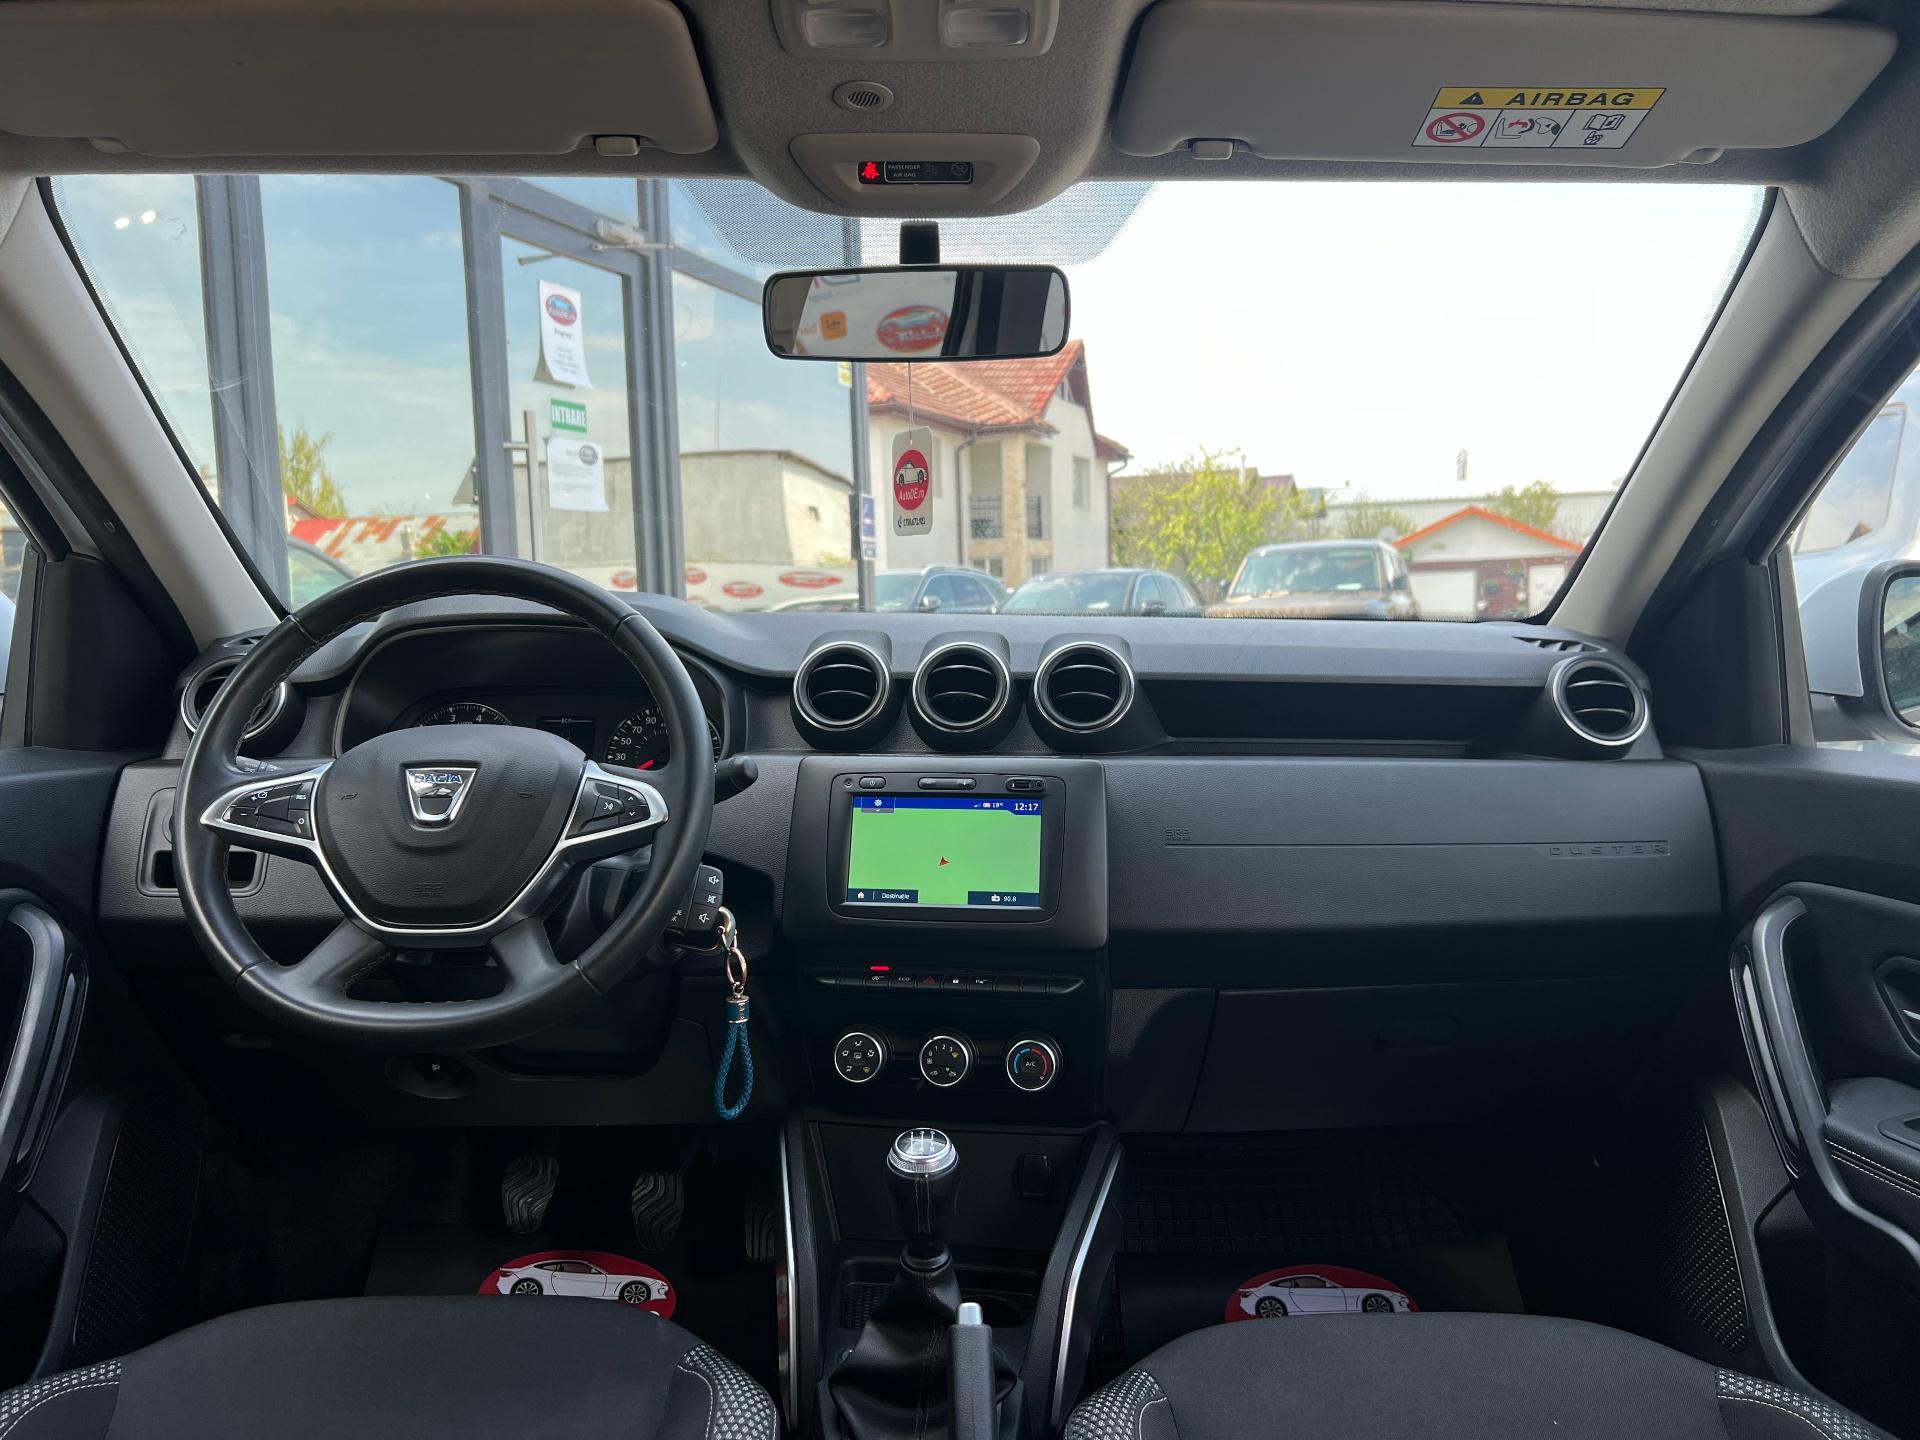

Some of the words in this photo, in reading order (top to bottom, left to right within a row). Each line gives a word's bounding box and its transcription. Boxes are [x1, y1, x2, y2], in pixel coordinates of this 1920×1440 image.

[1505, 92, 1635, 106] AIRBAG
[551, 405, 587, 427] INTRARE
[450, 714, 456, 723] 3
[475, 714, 482, 722] 4
[645, 716, 657, 725] 90
[632, 726, 643, 734] 70
[620, 737, 632, 746] 50
[614, 752, 626, 761] 30
[414, 773, 463, 784] DACIA
[1014, 802, 1039, 811] 12:17
[1549, 844, 1665, 856] DUSTER
[1003, 895, 1017, 903] 90.8
